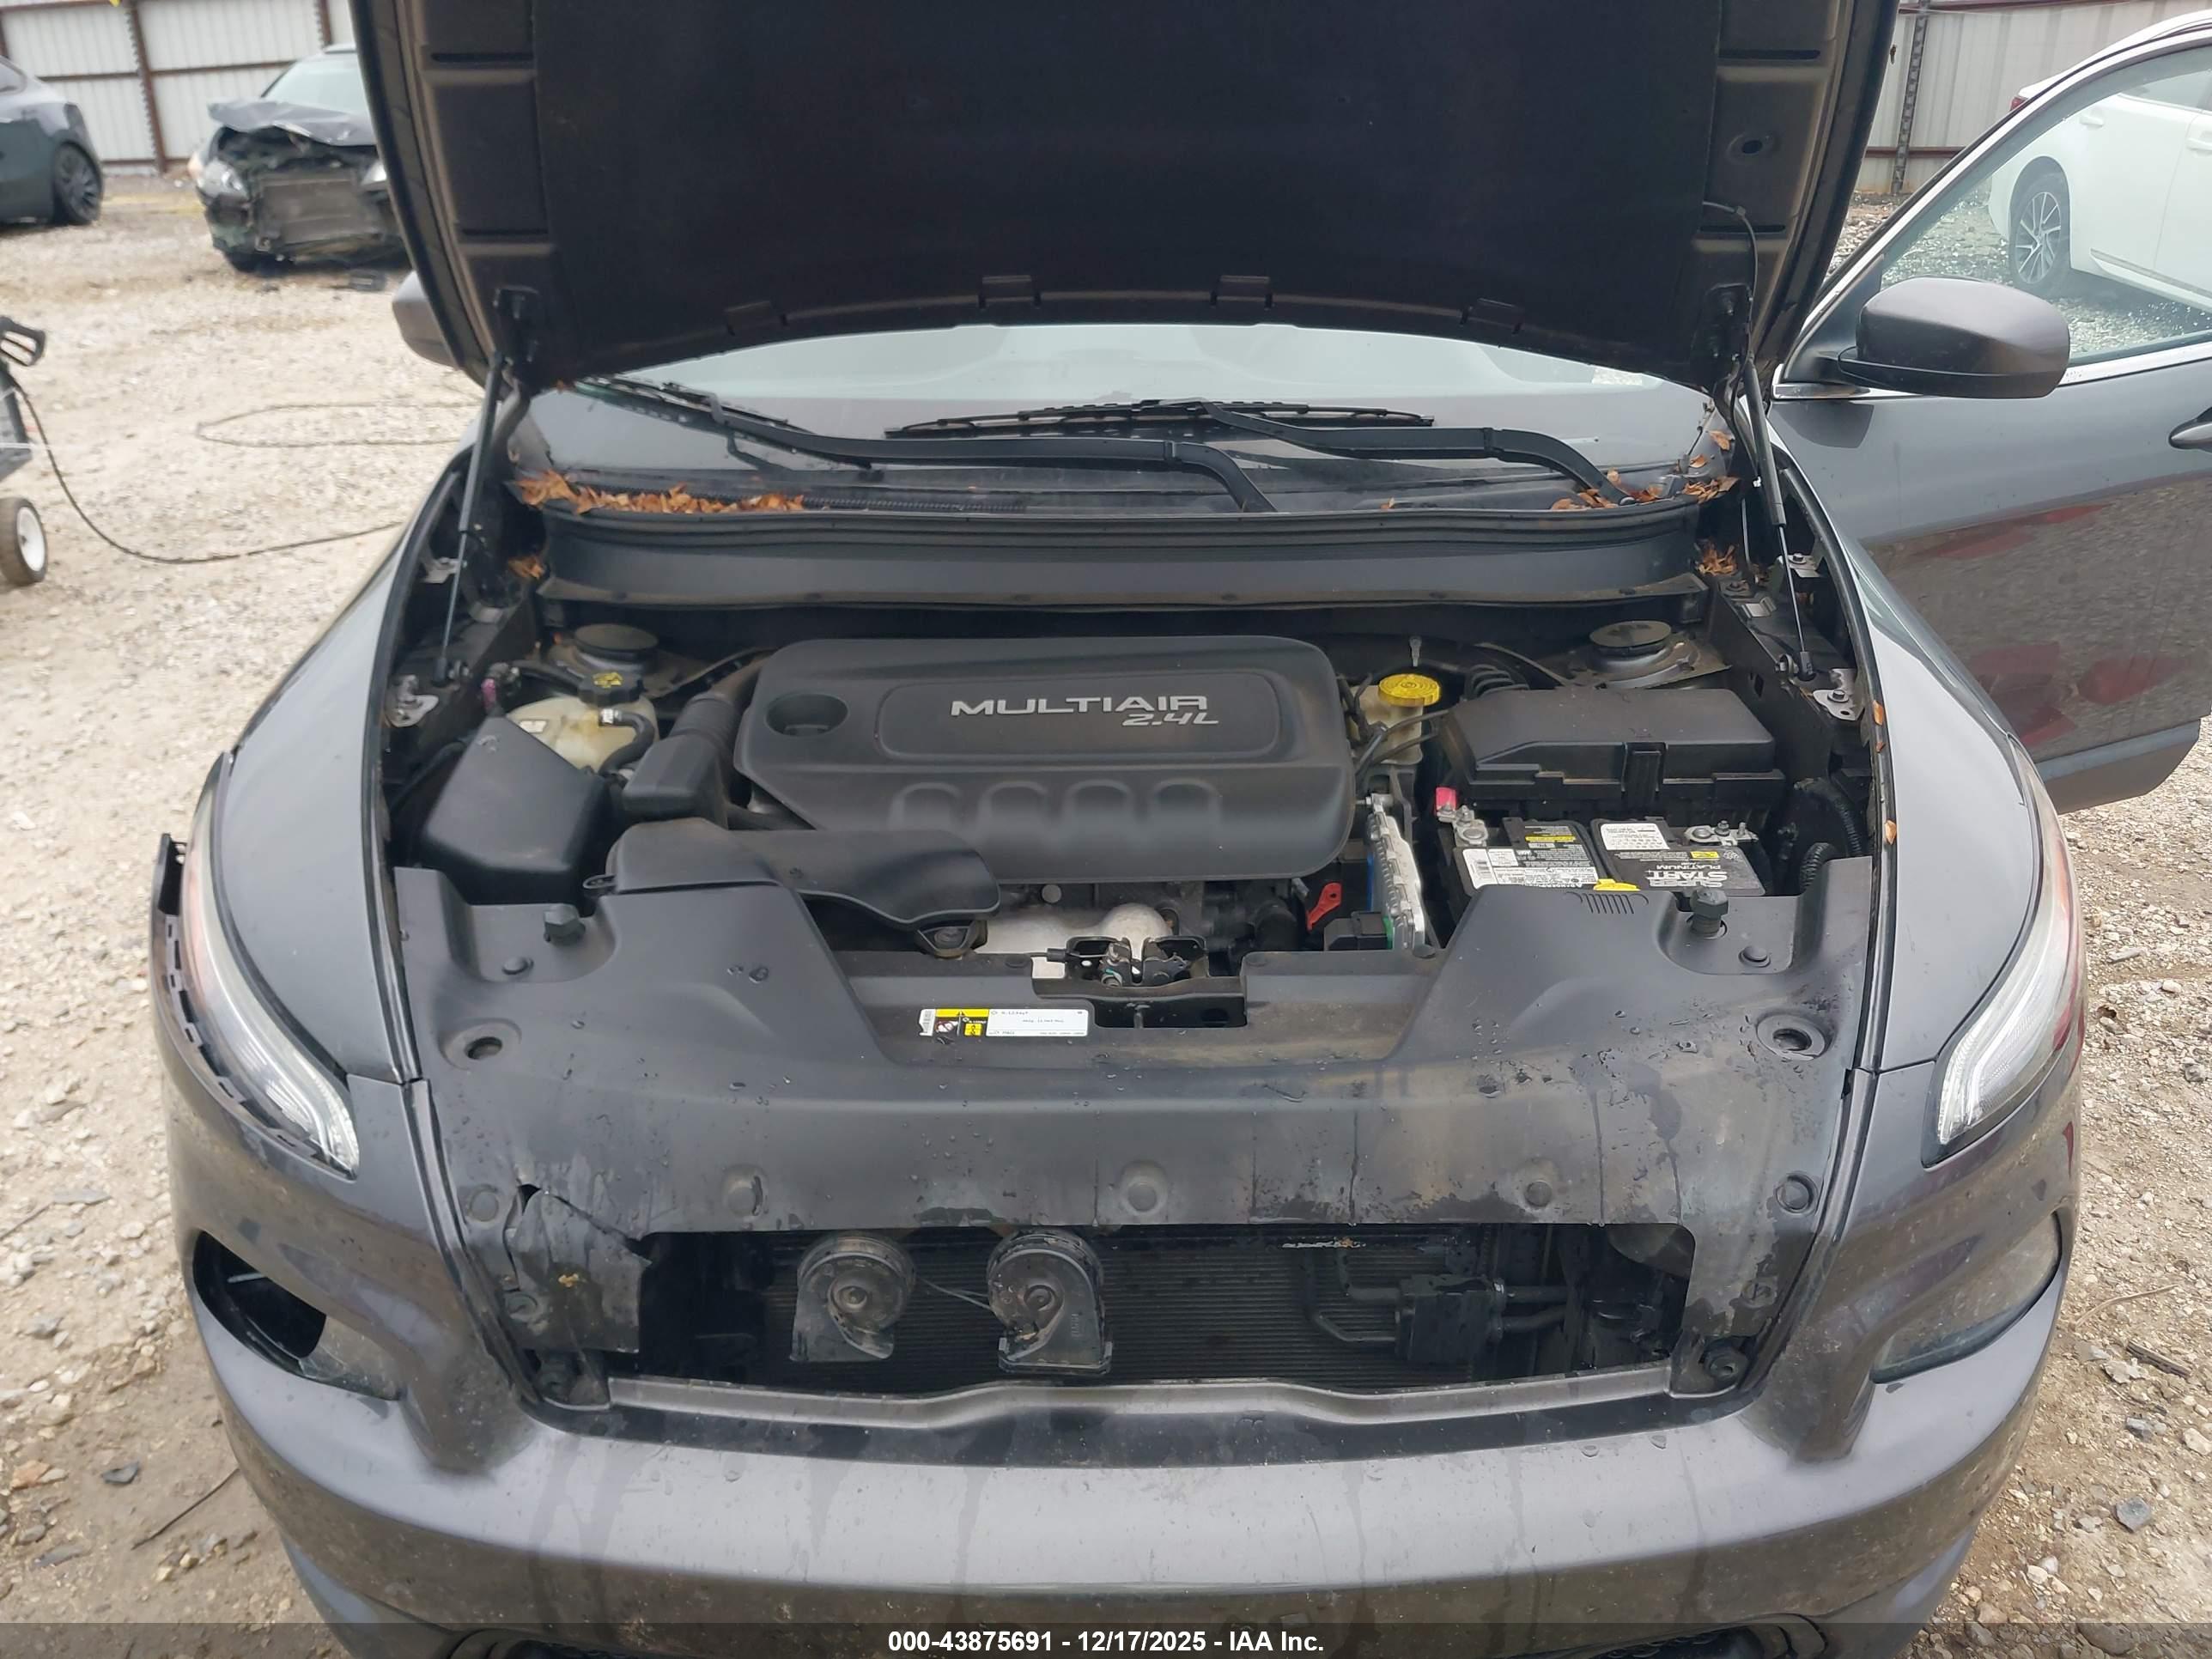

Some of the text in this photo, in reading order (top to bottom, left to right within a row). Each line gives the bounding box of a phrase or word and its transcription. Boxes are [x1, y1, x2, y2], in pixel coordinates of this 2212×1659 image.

[951, 696, 1207, 715] MULTIAIR
[1121, 712, 1219, 726] 2.4L
[1646, 871, 1728, 880] START
[1650, 878, 1723, 888] SUPER
